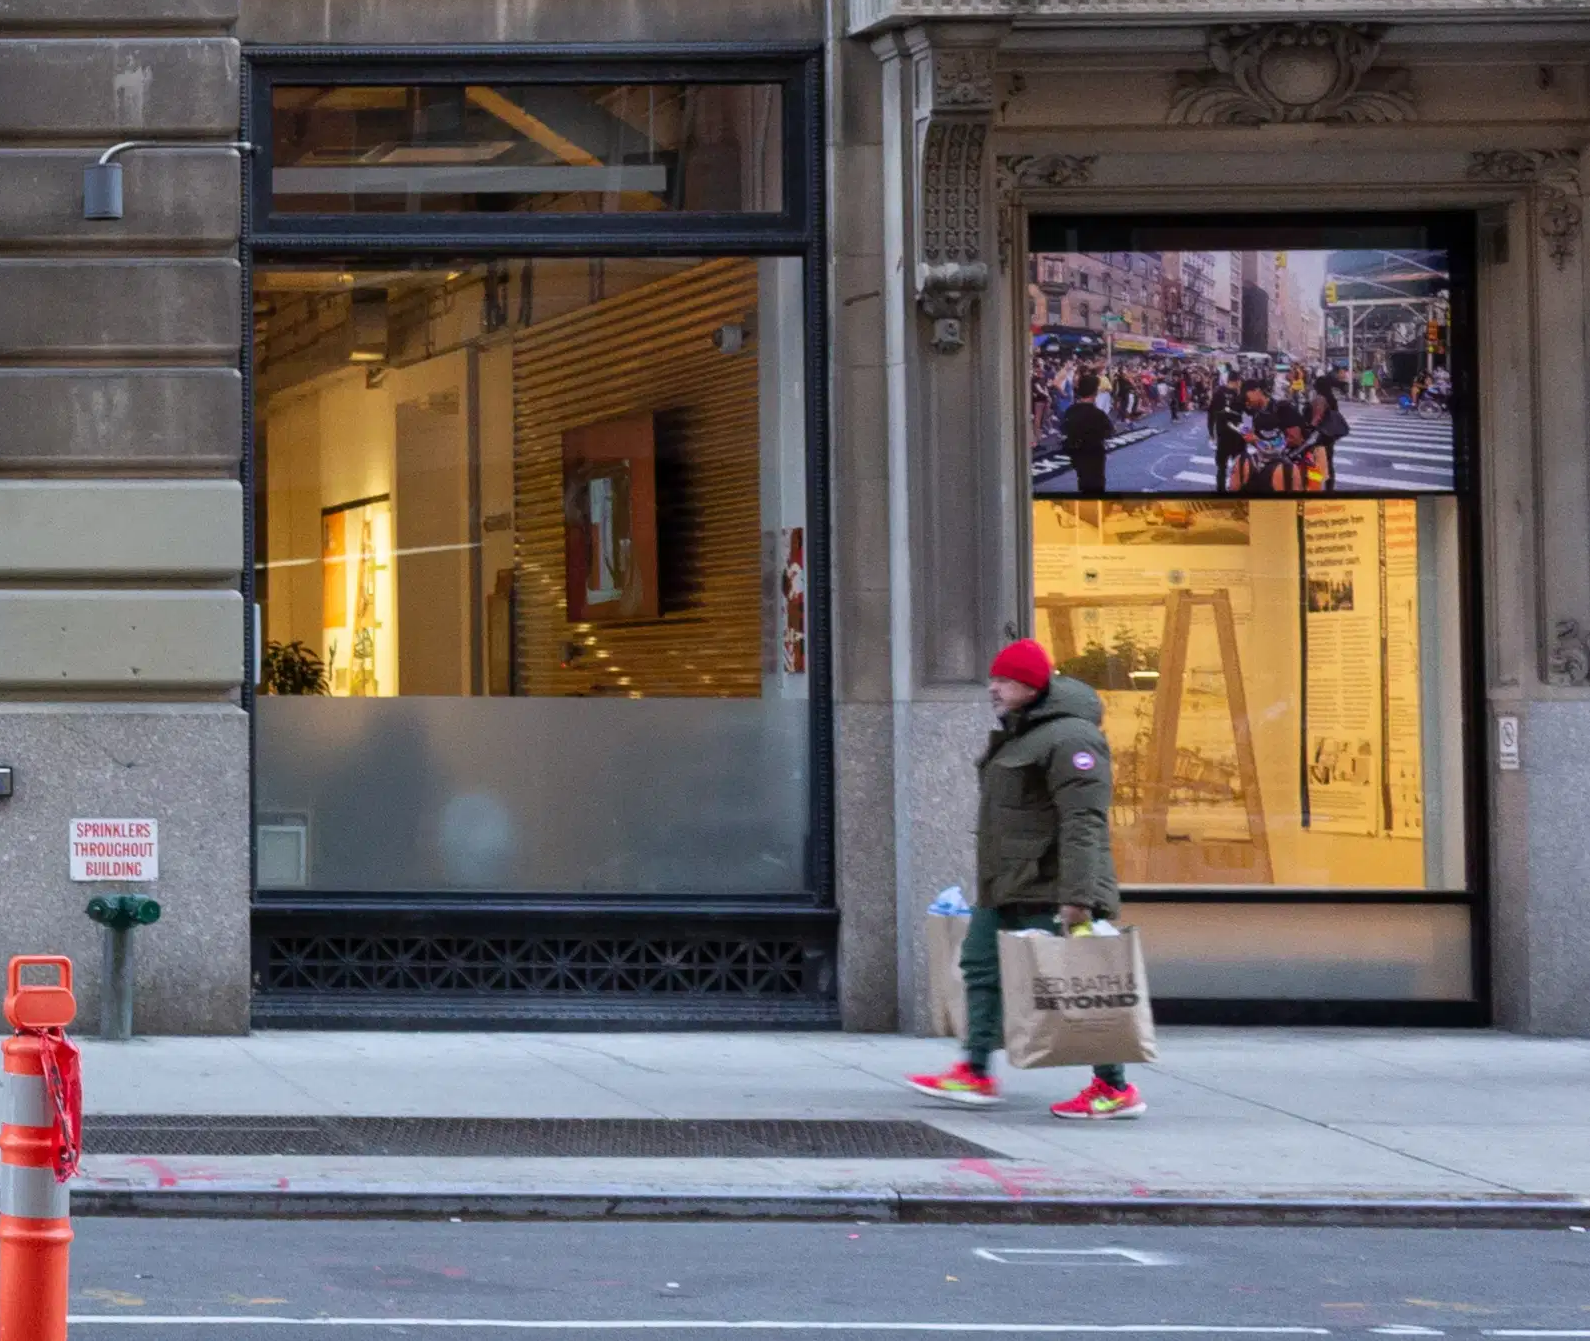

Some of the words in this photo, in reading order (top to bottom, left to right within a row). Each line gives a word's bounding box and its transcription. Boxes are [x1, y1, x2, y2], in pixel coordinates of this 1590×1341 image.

[76, 822, 151, 839] SPRINKLERS
[72, 842, 155, 858] THROUGHOUT
[85, 861, 142, 877] BUILDING
[1070, 973, 1121, 994] BATH
[1032, 994, 1139, 1011] BEYOND
